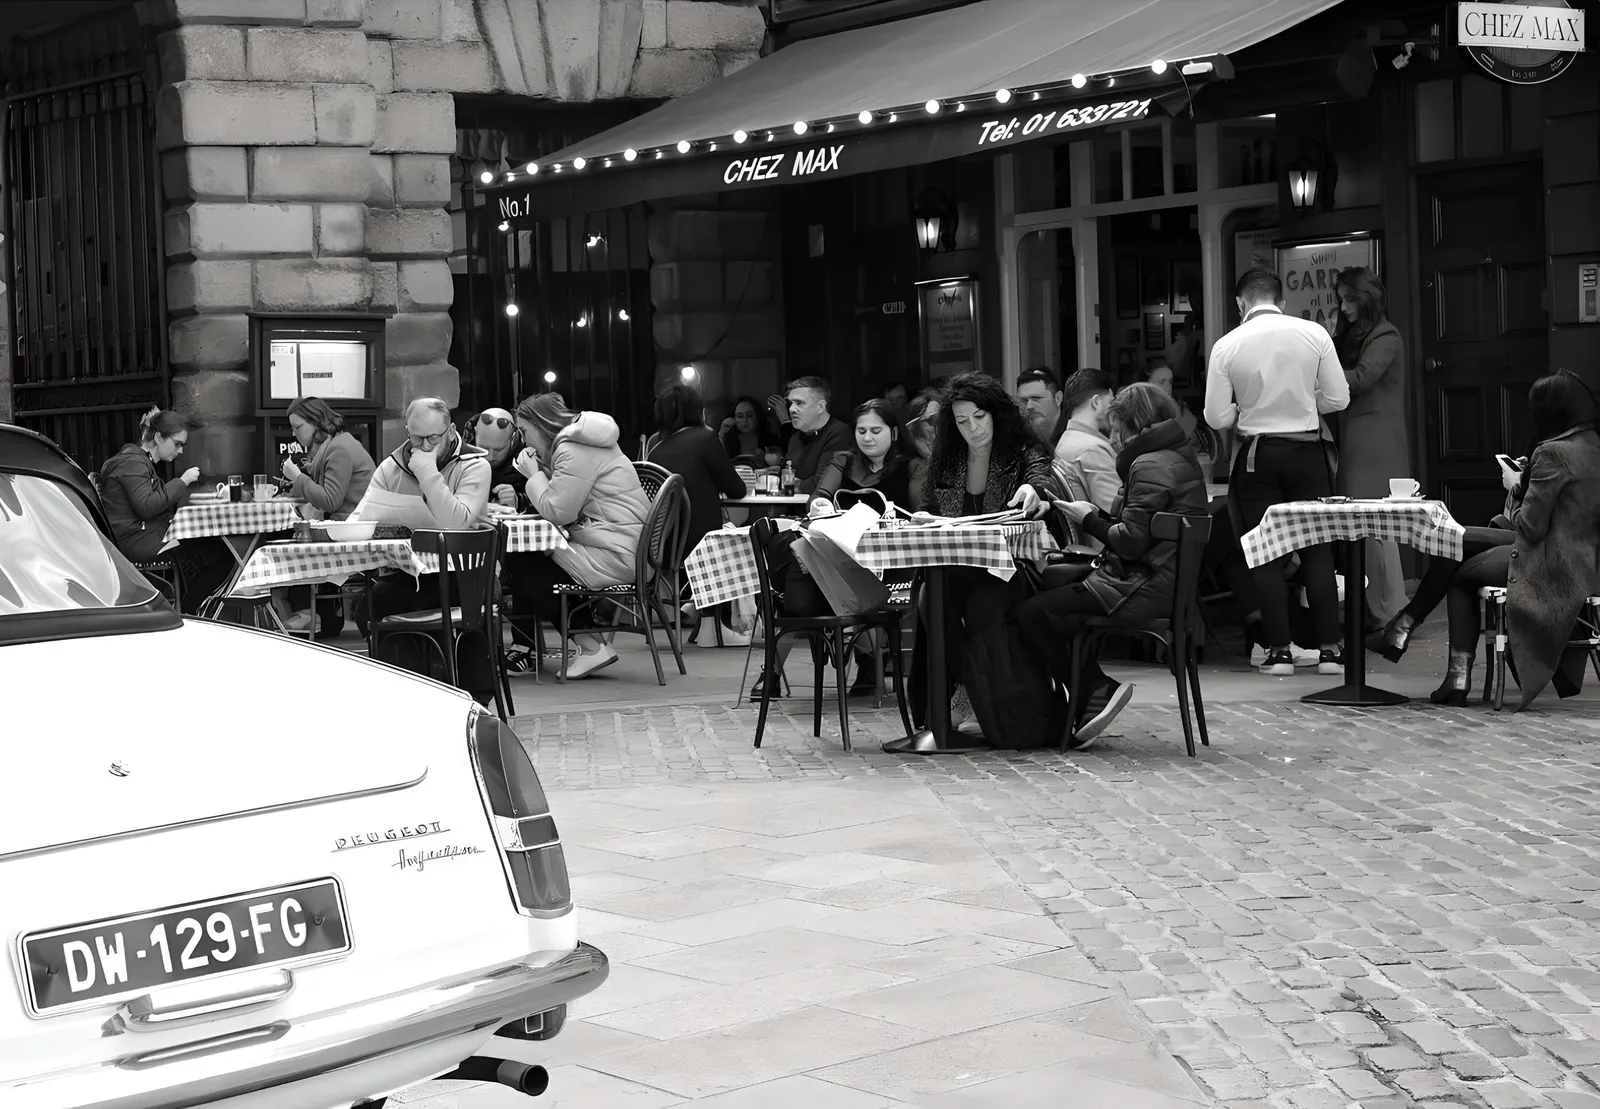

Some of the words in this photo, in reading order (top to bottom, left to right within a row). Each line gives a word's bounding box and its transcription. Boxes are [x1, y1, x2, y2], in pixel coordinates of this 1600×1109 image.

[1464, 11, 1524, 39] CHEZ
[1530, 15, 1580, 42] MAX
[977, 117, 1020, 145] Tel:
[1022, 111, 1057, 136] 01
[1056, 98, 1152, 129] 633721
[723, 153, 785, 184] CHEZ
[791, 144, 845, 176] MAX
[499, 193, 530, 219] No.1
[1286, 266, 1350, 291] GARD
[334, 820, 441, 850] PEUGEOT
[62, 897, 308, 993] DW-129-FG
